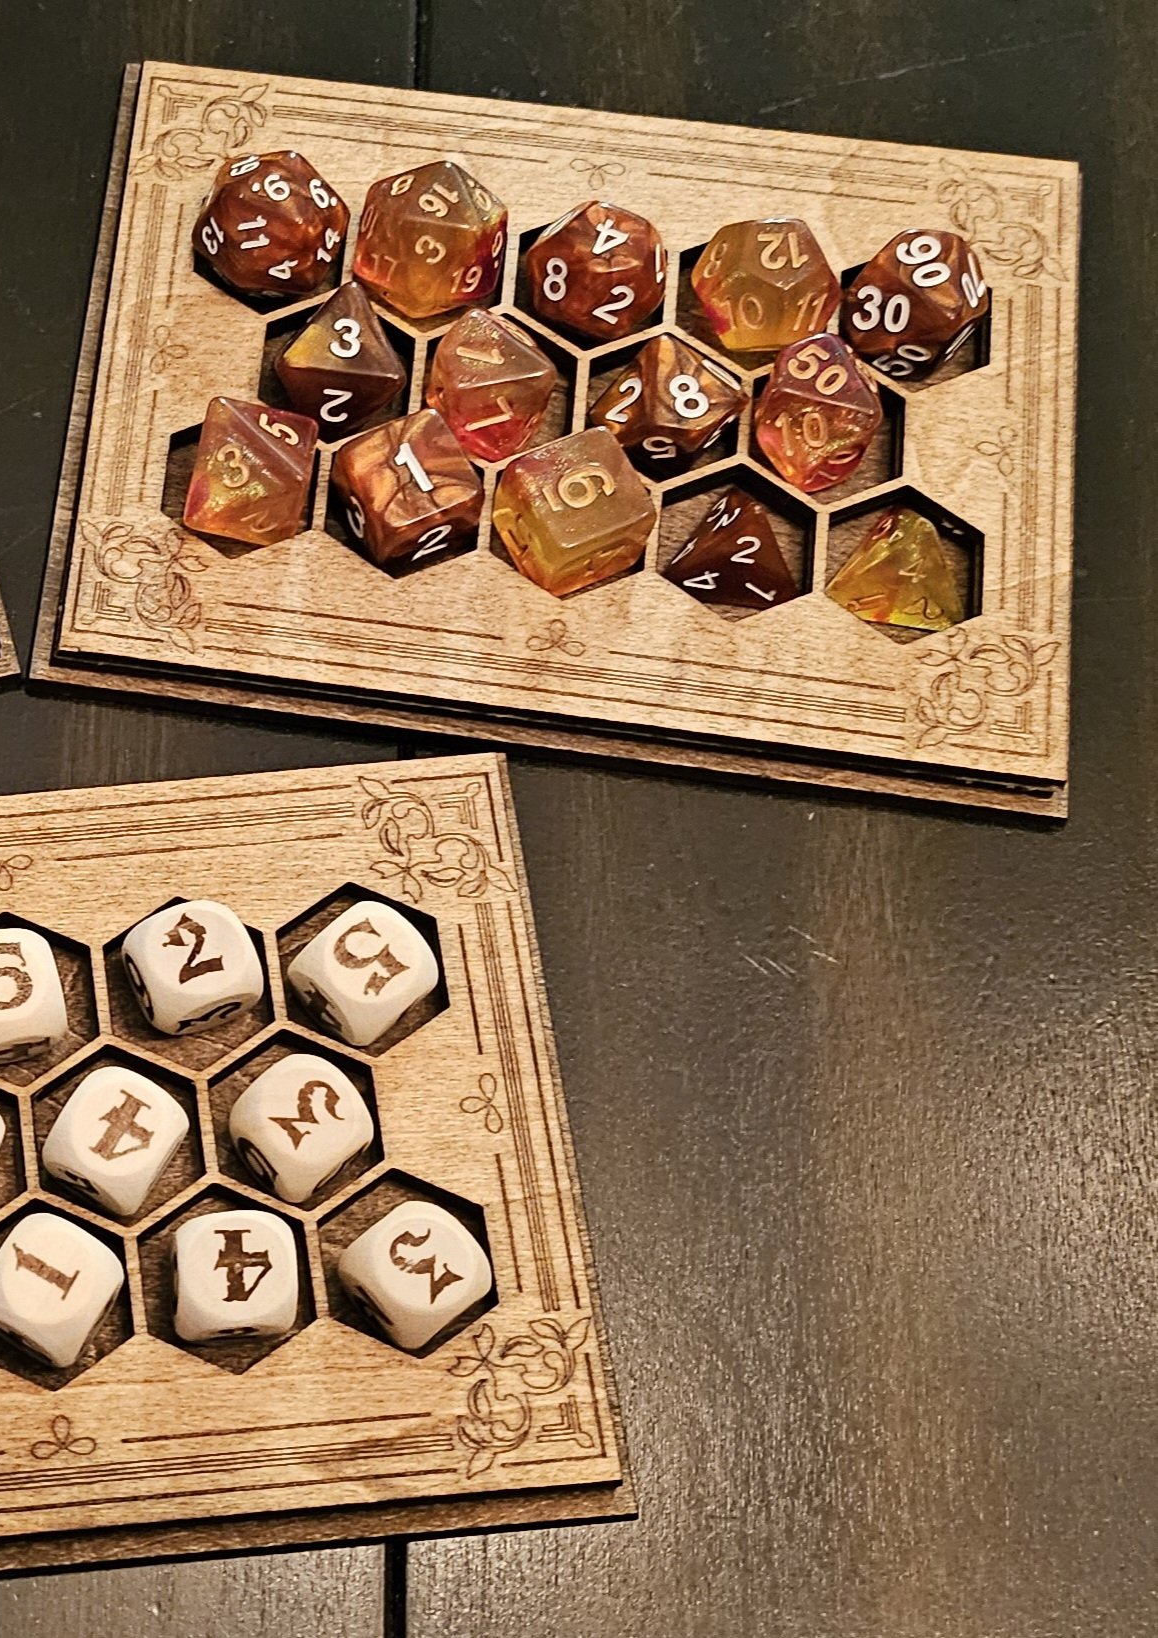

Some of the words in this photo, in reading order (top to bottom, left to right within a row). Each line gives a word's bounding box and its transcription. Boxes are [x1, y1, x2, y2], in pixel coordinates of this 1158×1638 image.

[202, 216, 225, 256] 13
[236, 214, 270, 250] 11
[316, 227, 341, 263] 14
[414, 235, 447, 265] 3
[592, 218, 630, 255] 4
[757, 231, 810, 271] 12
[268, 259, 299, 280] 4
[450, 264, 483, 294] 19
[543, 257, 568, 302] 8
[592, 285, 635, 325] 2
[793, 292, 829, 332] 11
[851, 285, 911, 333] 30
[329, 317, 362, 359] 3
[787, 343, 849, 396] 50
[871, 344, 933, 377] 50
[319, 388, 354, 423] 2
[604, 376, 642, 423] 2
[668, 374, 710, 419] 8
[258, 412, 300, 446] 5
[642, 436, 677, 460] 5
[774, 411, 828, 457] 10
[216, 442, 250, 488] 3
[393, 441, 435, 492] 1
[410, 524, 453, 562] 2
[729, 535, 762, 565] 2
[682, 570, 721, 590] 4
[898, 557, 928, 584] 4
[161, 912, 225, 985] 2
[333, 917, 411, 997] 5
[88, 1088, 155, 1162] 4
[12, 1242, 81, 1302] 1
[213, 1229, 273, 1303] 4
[389, 1227, 466, 1305] 3
